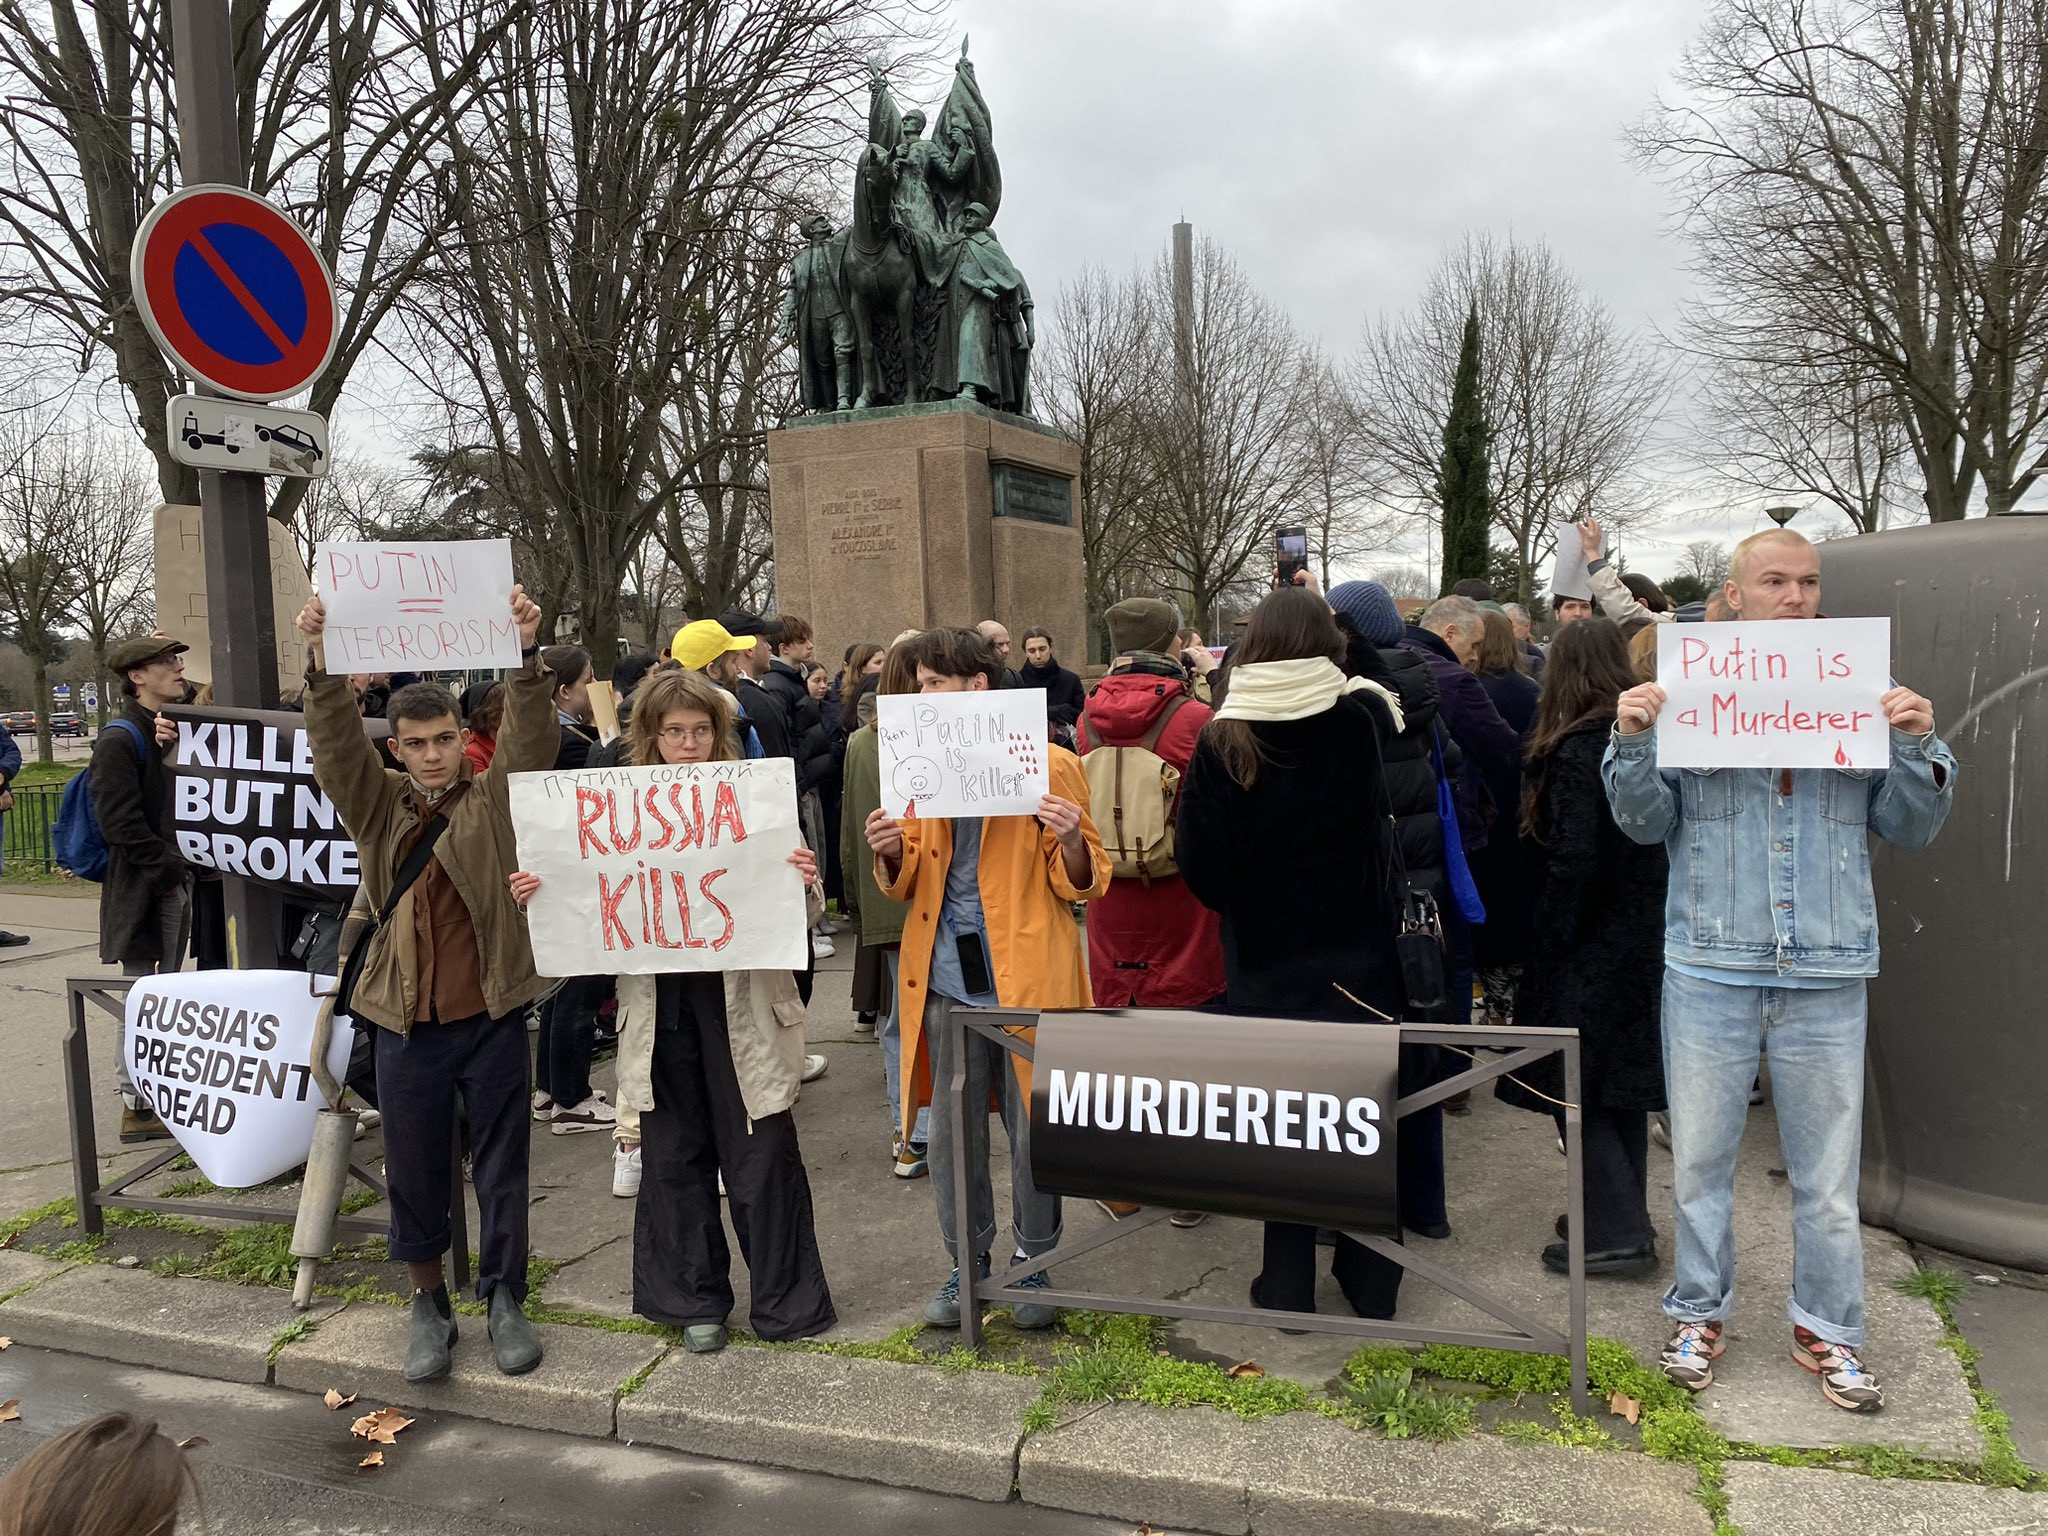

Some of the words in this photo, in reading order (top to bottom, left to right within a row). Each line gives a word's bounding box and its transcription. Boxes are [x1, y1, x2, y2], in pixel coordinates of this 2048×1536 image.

[328, 550, 458, 595] PUTIN
[328, 617, 519, 663] TERRORISM
[1681, 636, 1788, 682] Putin
[1816, 647, 1852, 682] is
[879, 727, 909, 746] Putin
[1676, 708, 1702, 728] a
[1712, 691, 1873, 738] Murderer
[177, 721, 314, 774] KILLE
[945, 747, 967, 773] is
[175, 775, 285, 828] BUT
[294, 784, 346, 830] N
[543, 770, 633, 798] ПУТИН
[650, 765, 705, 783] СОСИ
[711, 762, 754, 780] ХУЙ
[175, 830, 360, 885] BROKE
[137, 993, 280, 1051] RUSSIA'S
[134, 1035, 312, 1102] PRESIDENT
[157, 1083, 237, 1135] DEAD
[1048, 1069, 1380, 1156] MURDERERS
